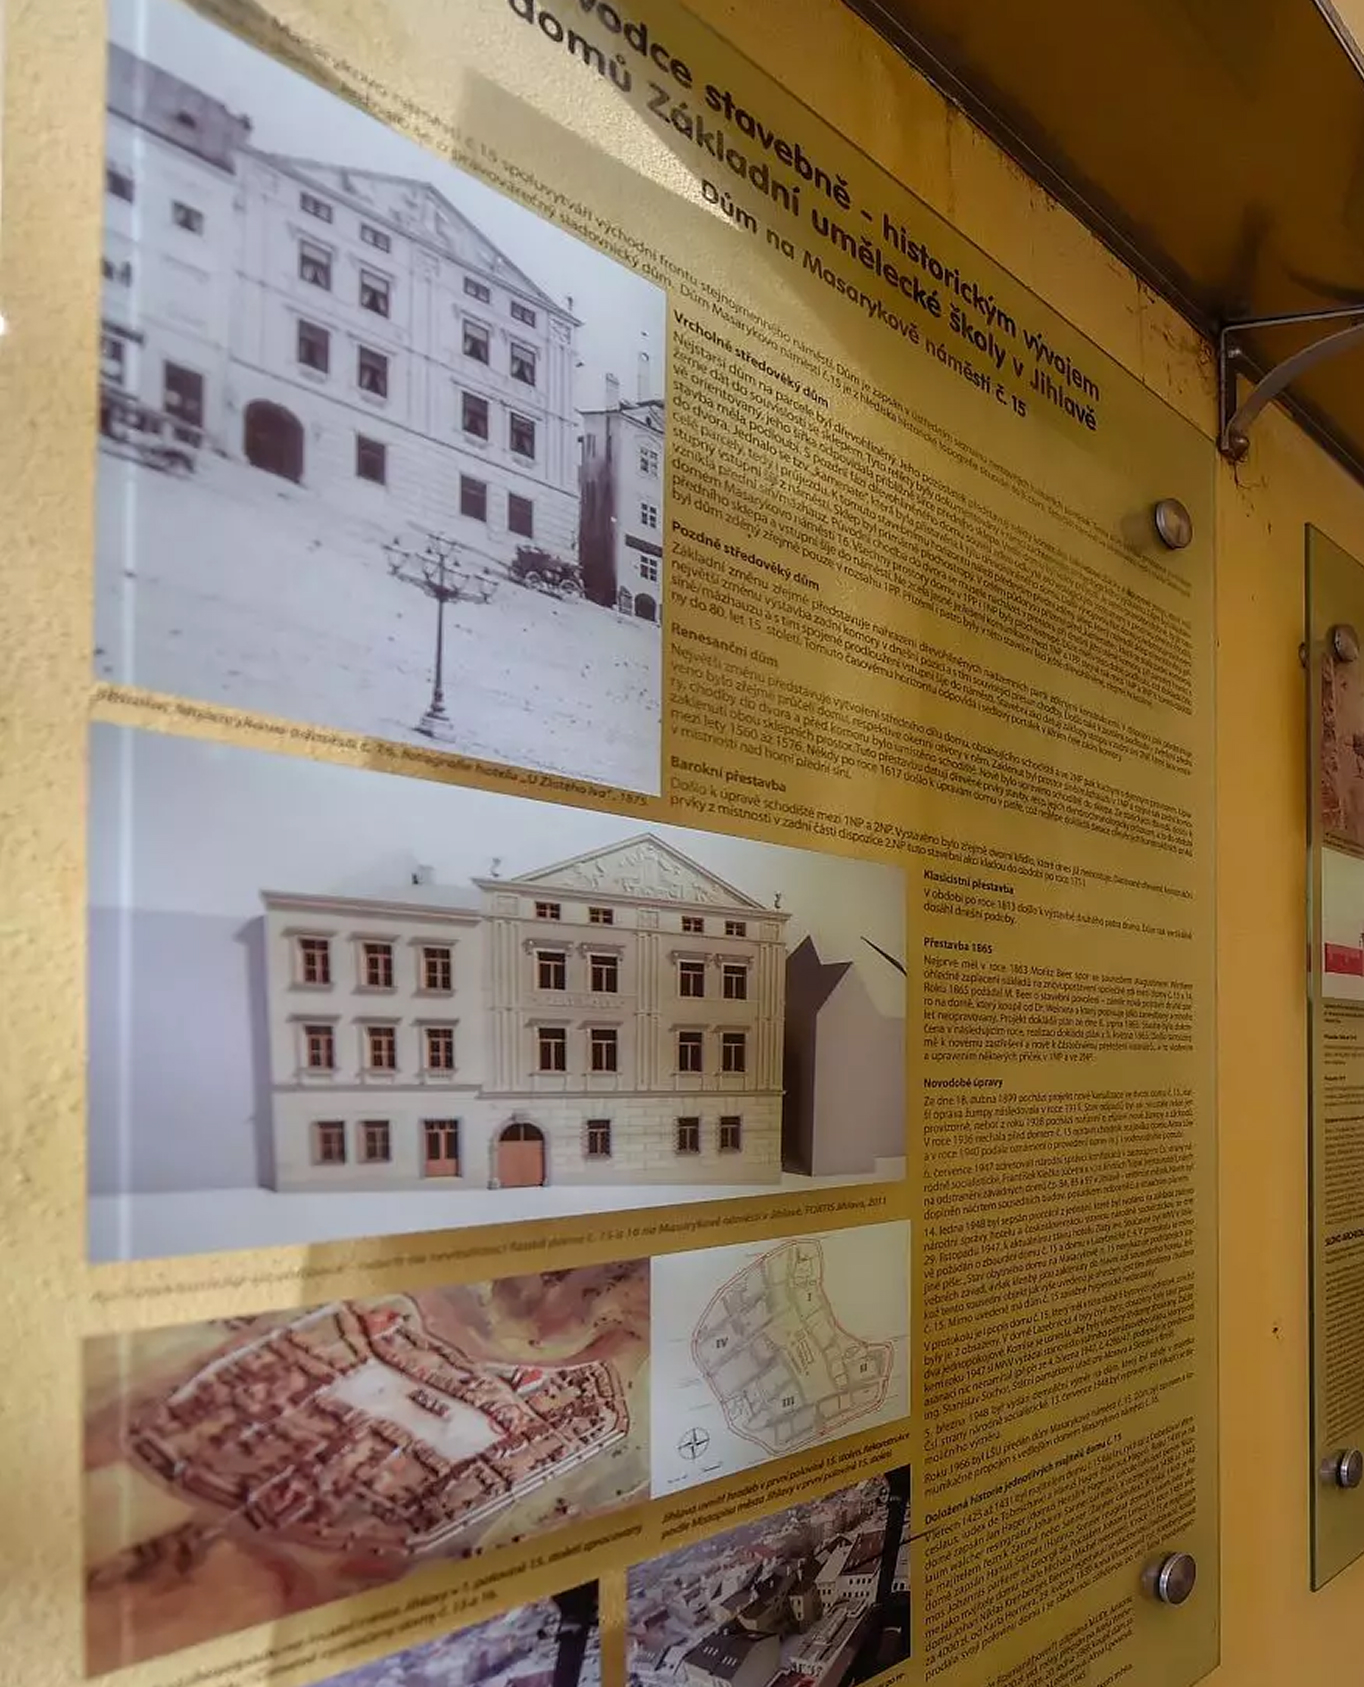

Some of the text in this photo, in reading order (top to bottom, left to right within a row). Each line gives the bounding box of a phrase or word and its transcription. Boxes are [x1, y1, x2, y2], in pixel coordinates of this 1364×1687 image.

[595, 219, 656, 264] východní
[646, 81, 800, 217] Základní
[812, 208, 941, 318] umělecké
[949, 303, 1006, 370] školy
[1013, 355, 1024, 378] v
[1030, 367, 1097, 432] Jihlavě
[705, 84, 851, 211] stavebně
[883, 213, 1016, 338] historickým
[1022, 326, 1100, 402] vývojem
[680, 283, 709, 311] Dům
[701, 179, 757, 234] Dům
[766, 227, 795, 260] na
[803, 249, 920, 345] Masarykově
[925, 339, 991, 394] náměstí
[1012, 393, 1027, 418] 15
[674, 309, 828, 408] Vrcholně středověký dům
[729, 362, 755, 386] dům
[672, 488, 691, 508] byl
[694, 497, 722, 520] dům
[672, 520, 819, 591] Pozdně středověký dům
[750, 648, 778, 667] dům
[671, 756, 786, 792] Barokní přestavba
[973, 1078, 1002, 1088] úpravy
